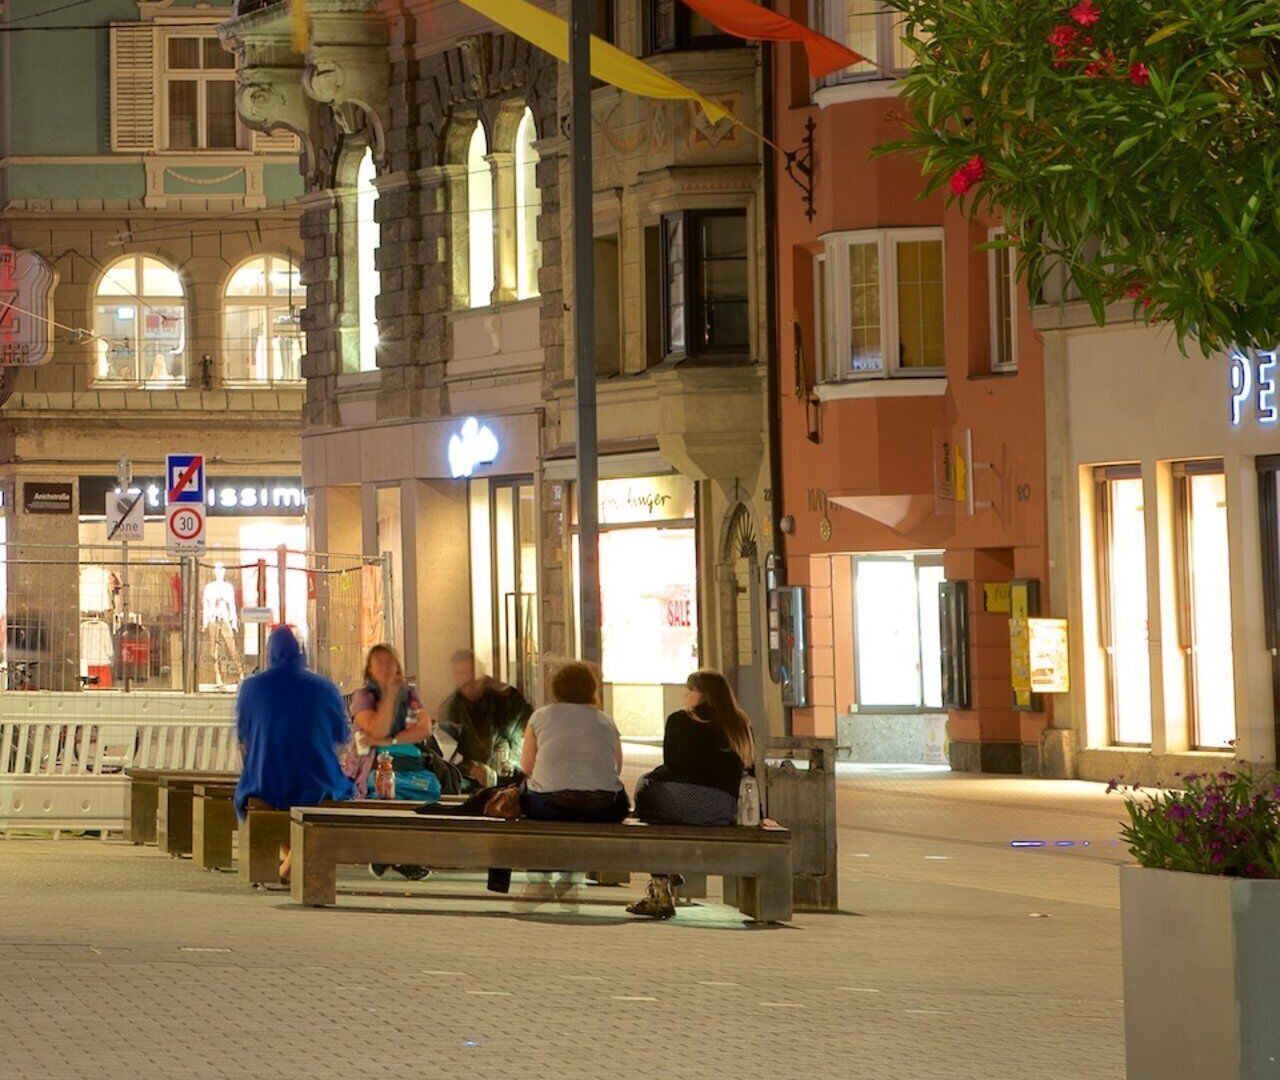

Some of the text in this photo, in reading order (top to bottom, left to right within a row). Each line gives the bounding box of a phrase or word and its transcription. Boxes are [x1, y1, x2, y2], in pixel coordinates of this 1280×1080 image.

[111, 520, 140, 532] Zone
[179, 516, 194, 531] 30
[667, 599, 691, 627] SALE
